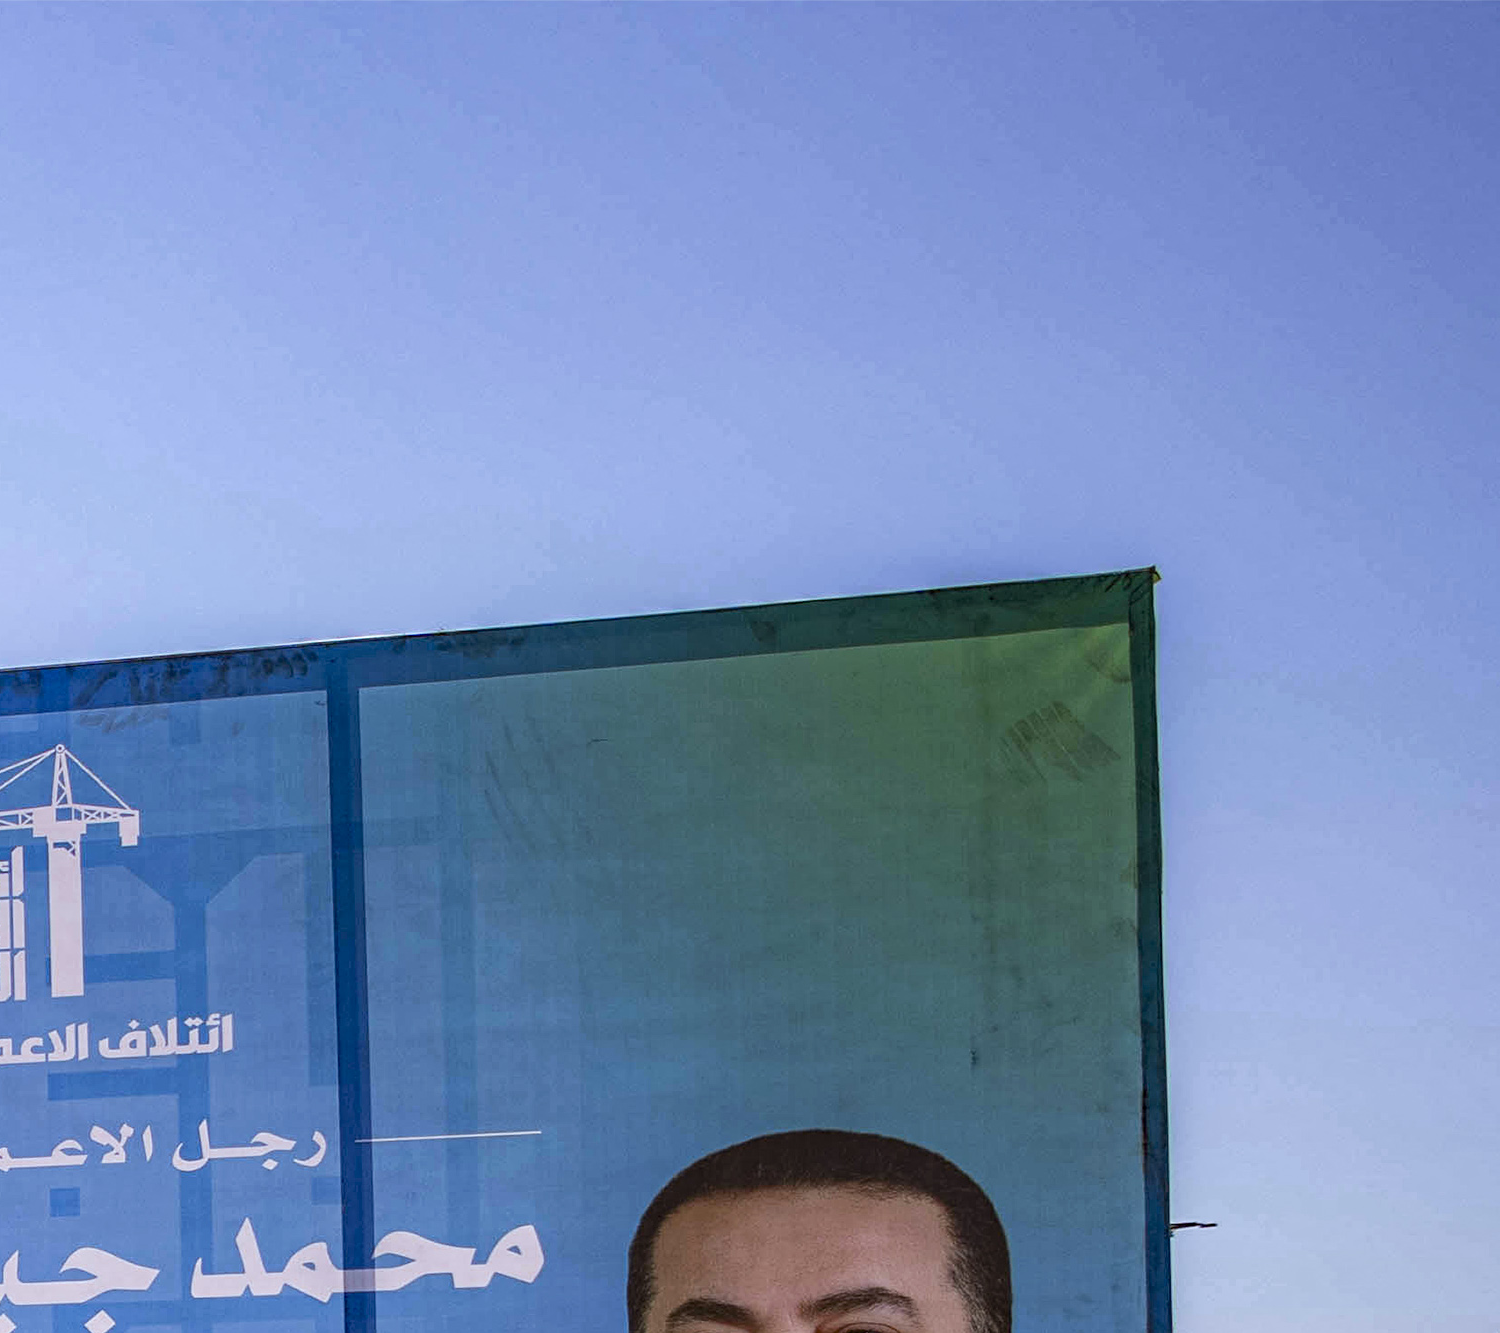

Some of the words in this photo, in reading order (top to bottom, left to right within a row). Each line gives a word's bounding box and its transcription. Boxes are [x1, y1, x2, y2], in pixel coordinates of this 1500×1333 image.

[99, 1013, 233, 1058] ائتلاف
[172, 1120, 326, 1171] رجل
[191, 1218, 544, 1302] محمد
